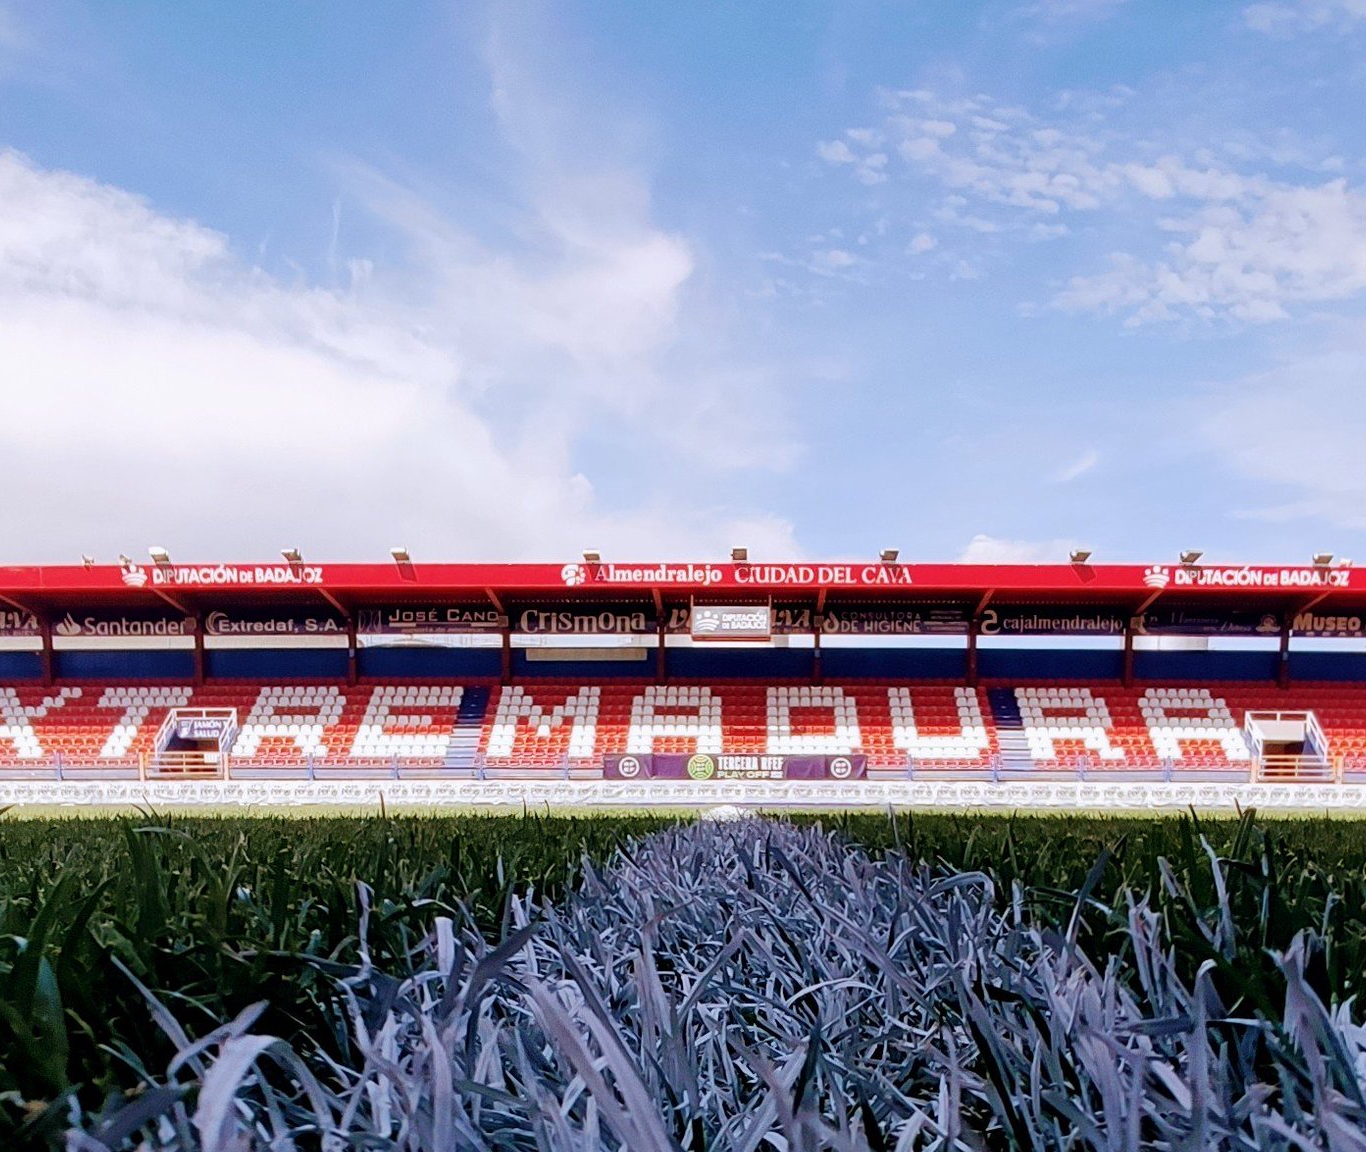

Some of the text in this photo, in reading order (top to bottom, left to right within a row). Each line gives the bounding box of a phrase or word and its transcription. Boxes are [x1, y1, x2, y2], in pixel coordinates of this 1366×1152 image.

[152, 565, 323, 584] DIPUTACIÓN DE BADAJOZ
[595, 563, 913, 586] Almendralejo CIUDAD DEL CAVA
[1174, 567, 1350, 587] DIPUTACIÓN DE BADAJOZ
[841, 611, 921, 621] CONSULTORA
[85, 617, 186, 635] Santander
[218, 618, 344, 633] Extredaf, S.A.
[840, 621, 859, 633] DE
[864, 621, 921, 633] HIGIENE
[1003, 615, 1123, 633] cajalmendralejo
[193, 729, 220, 738] SALUD
[717, 756, 784, 770] TERCERA RFEF
[717, 770, 745, 779] PLAY
[746, 770, 770, 779] OFF
